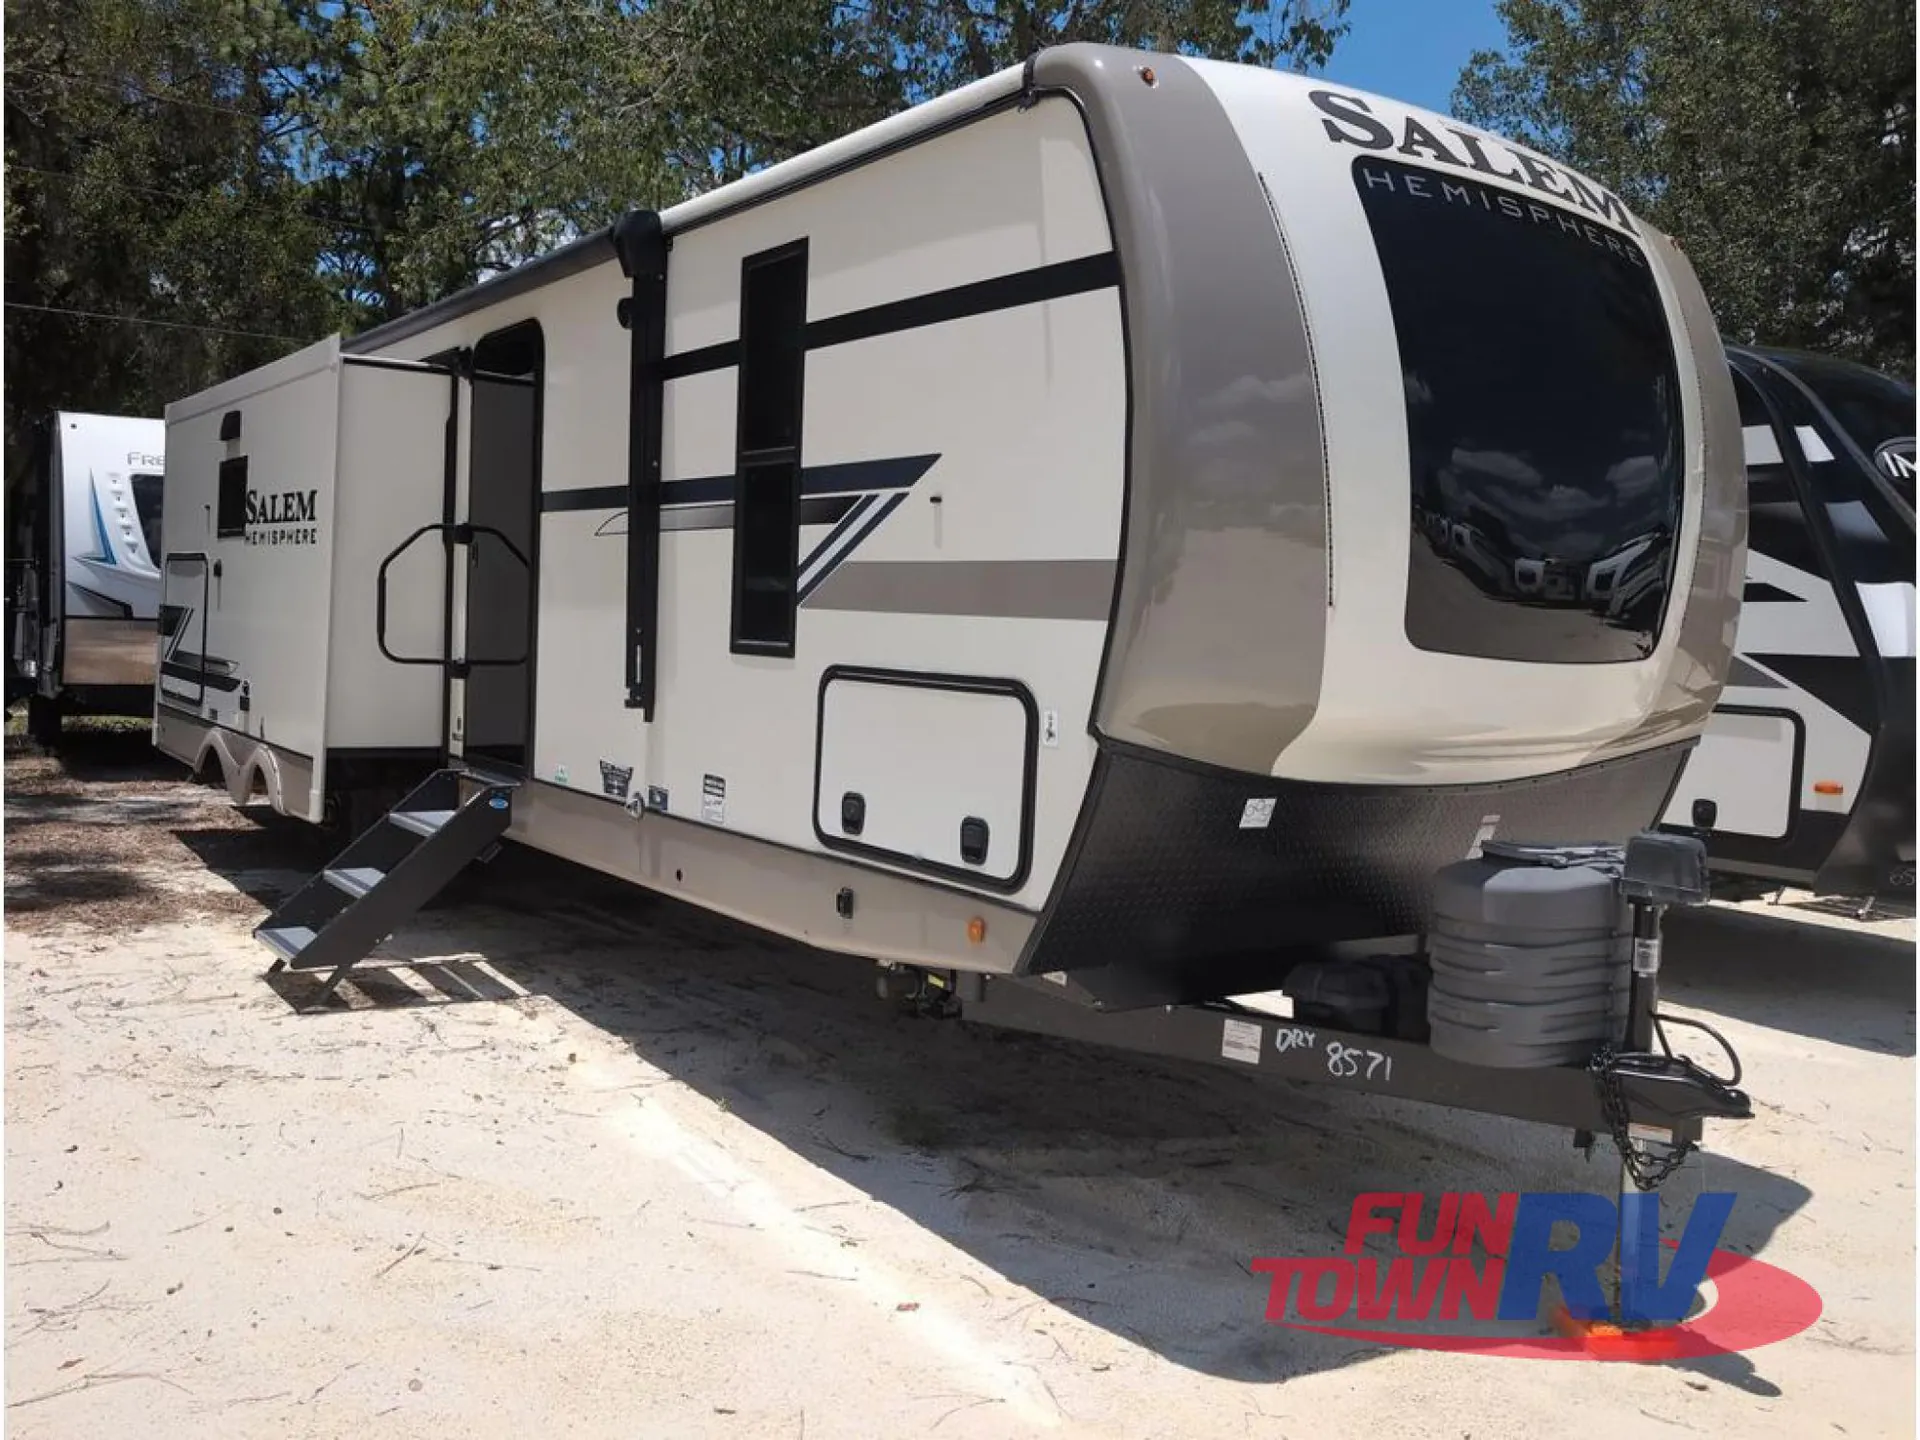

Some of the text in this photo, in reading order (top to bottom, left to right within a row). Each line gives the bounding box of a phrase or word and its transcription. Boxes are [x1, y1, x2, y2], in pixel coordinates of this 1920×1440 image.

[1308, 89, 1641, 237] SALEM
[1362, 167, 1645, 267] HEMISPHERE
[245, 489, 318, 525] SALEM
[245, 528, 317, 545] HEMISPHERE
[1275, 1028, 1316, 1052] DRY
[1327, 1041, 1392, 1081] 8571
